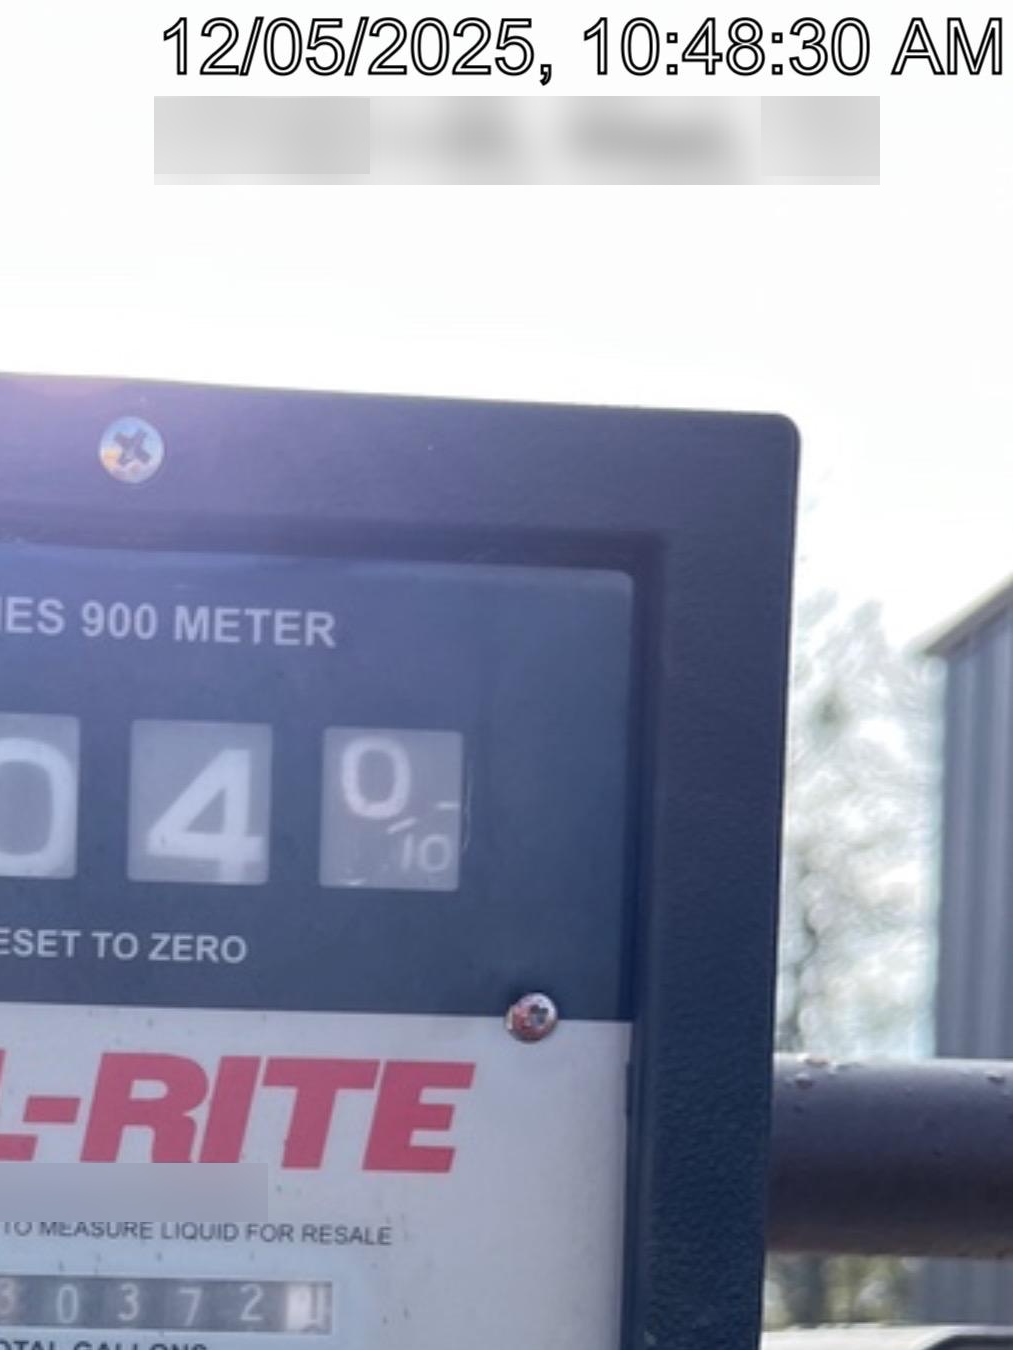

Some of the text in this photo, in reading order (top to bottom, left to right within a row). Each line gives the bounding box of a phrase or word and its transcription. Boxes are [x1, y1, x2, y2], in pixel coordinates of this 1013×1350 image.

[81, 601, 159, 645] 900
[174, 604, 337, 649] METER
[91, 931, 139, 962] TO
[148, 932, 248, 965] ZERO
[38, 1221, 154, 1240] MEASURE
[161, 1222, 239, 1243] LIQUID
[245, 1223, 294, 1243] FOR
[300, 1224, 393, 1247] RESALE
